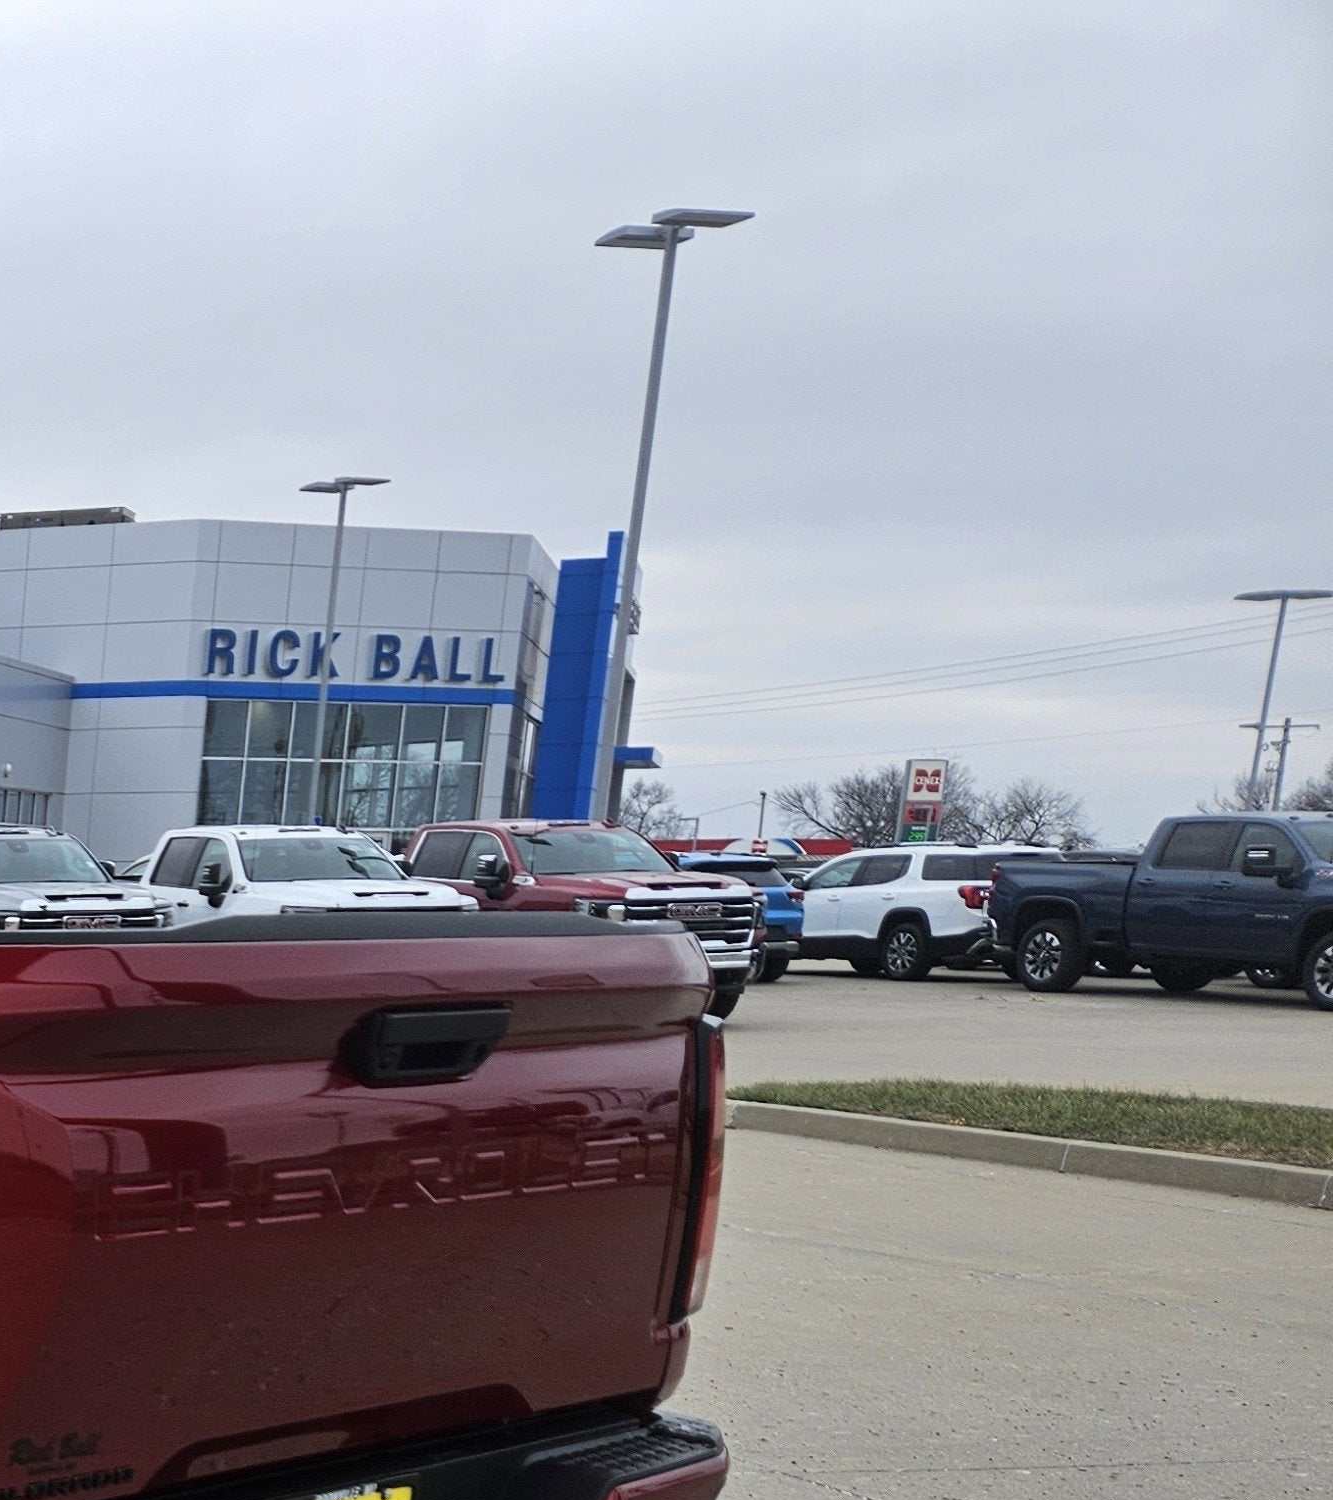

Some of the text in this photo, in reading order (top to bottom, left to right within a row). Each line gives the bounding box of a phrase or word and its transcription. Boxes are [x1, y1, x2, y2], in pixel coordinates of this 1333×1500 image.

[205, 628, 505, 683] RICK BALL
[672, 905, 721, 917] GMC
[66, 918, 119, 929] GMC
